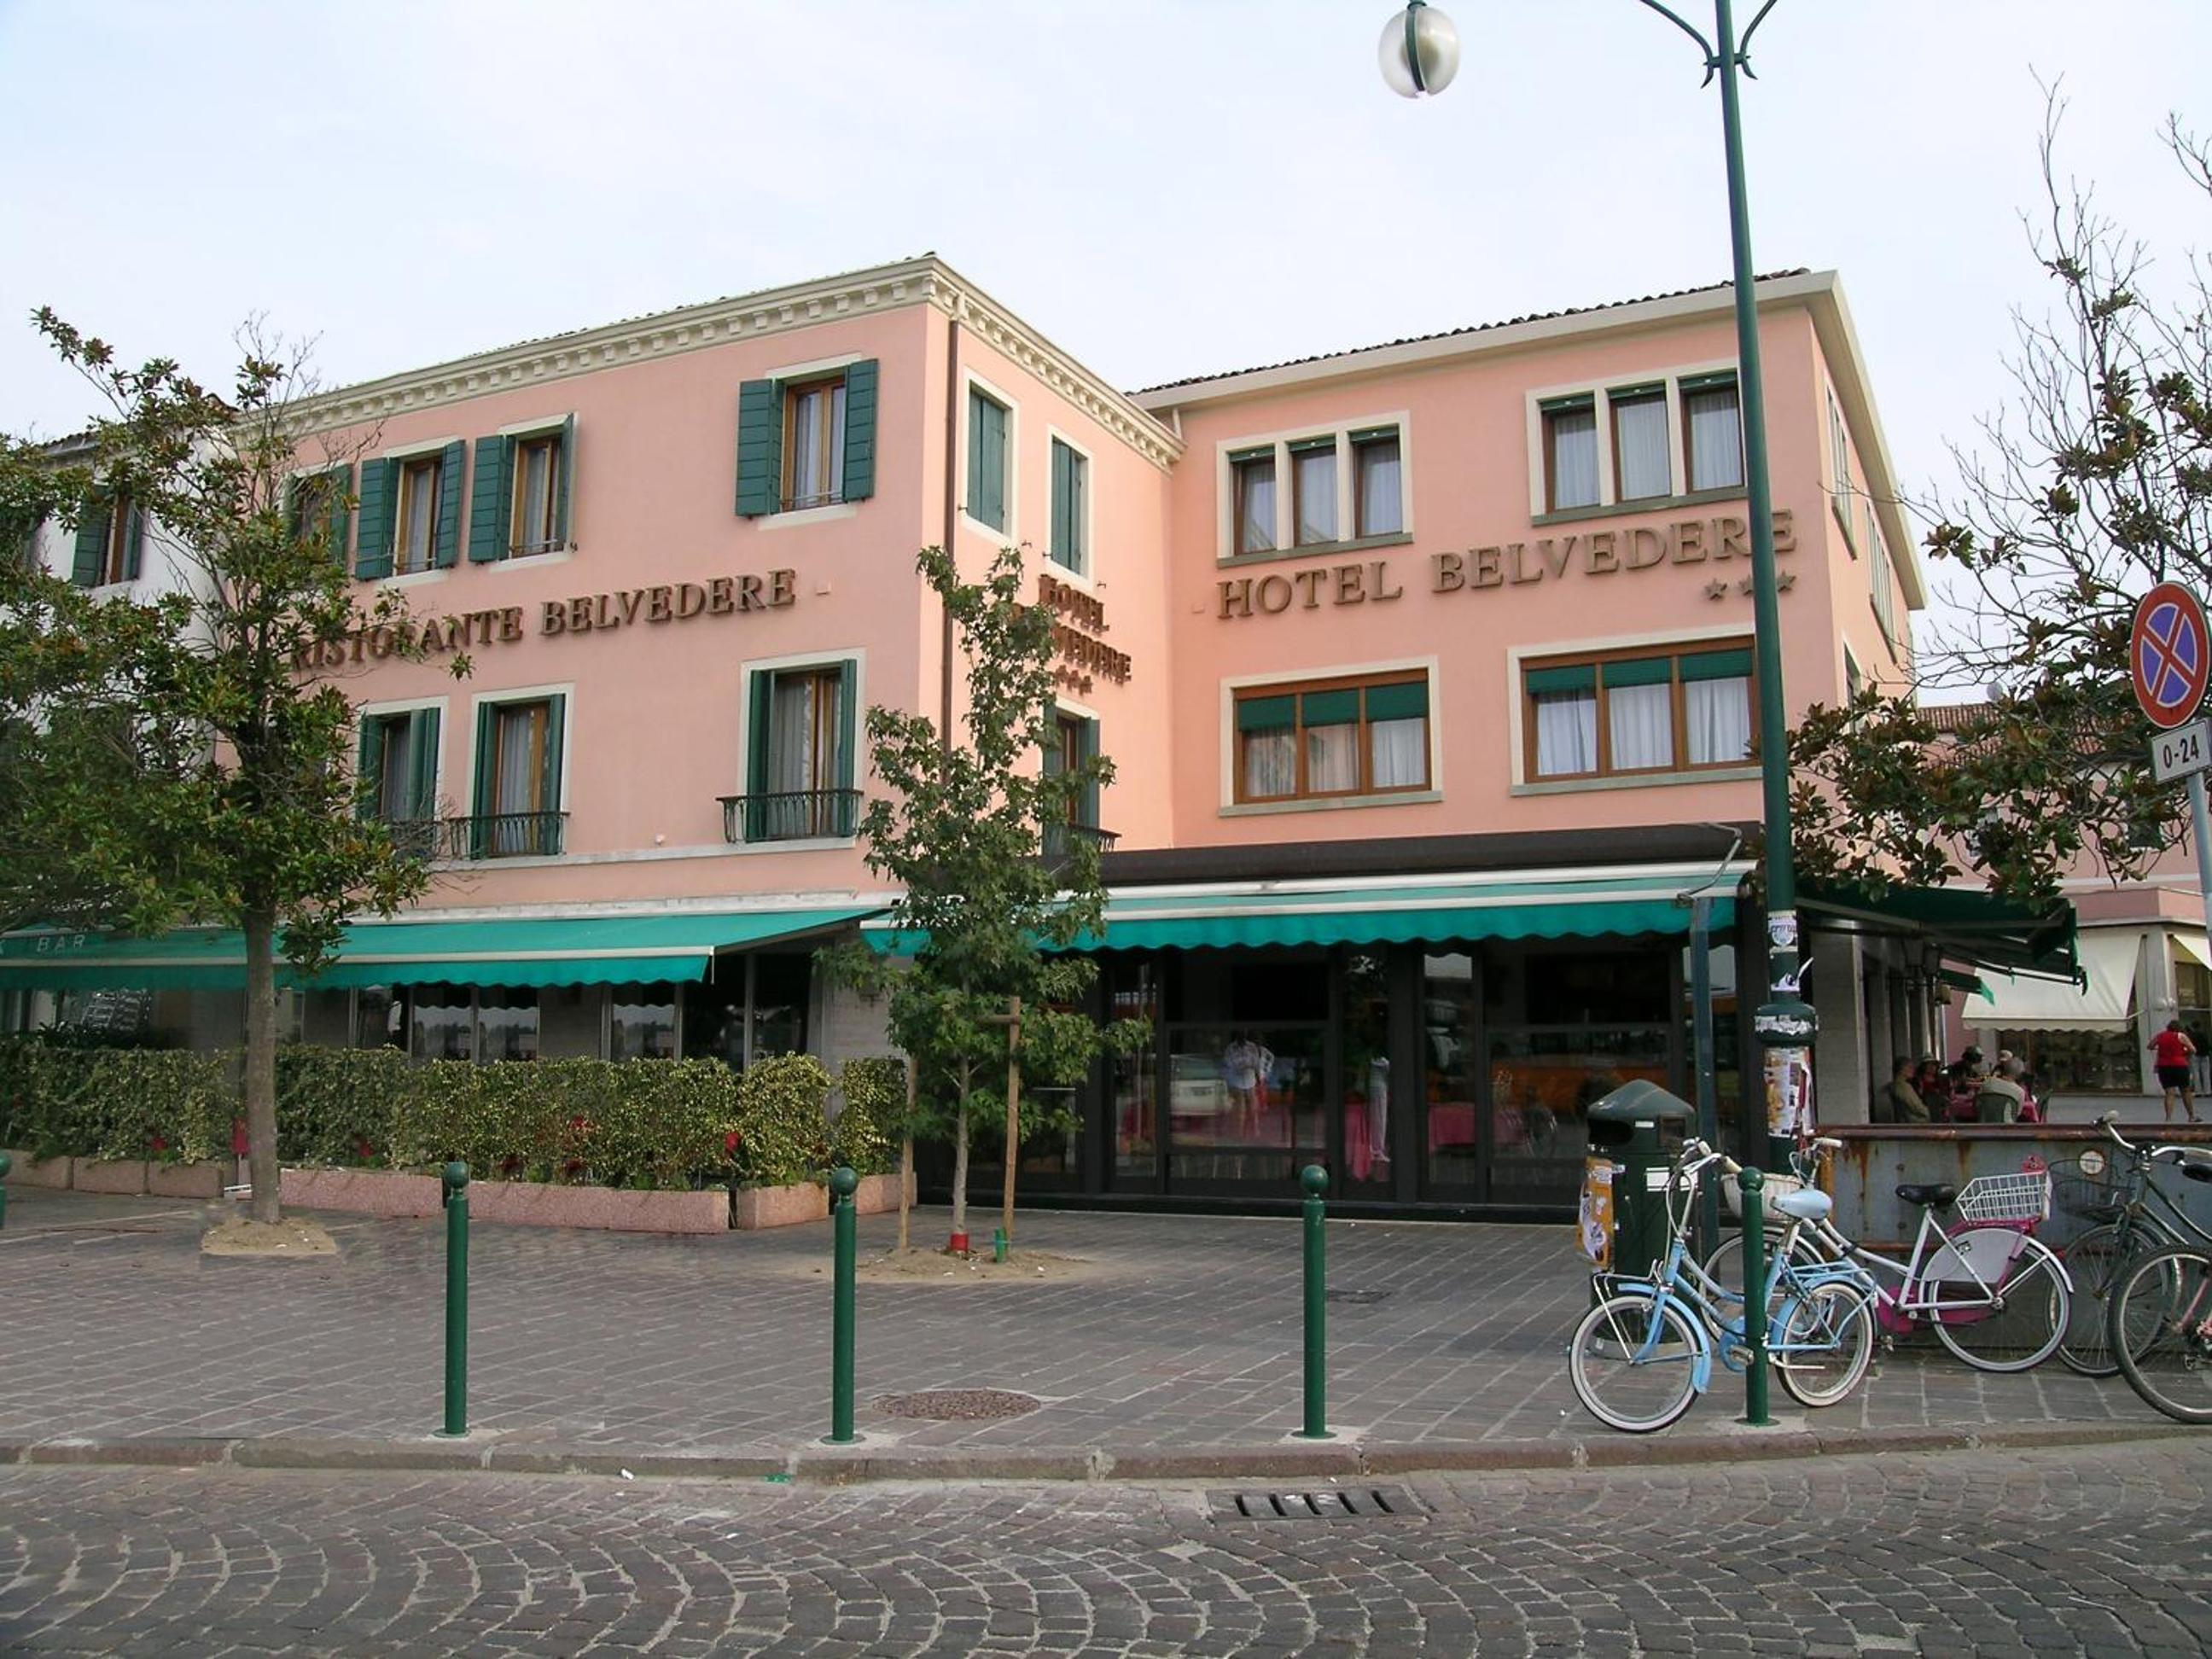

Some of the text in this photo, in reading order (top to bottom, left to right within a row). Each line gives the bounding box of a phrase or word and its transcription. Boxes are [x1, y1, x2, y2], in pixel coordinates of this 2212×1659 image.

[1216, 509, 1797, 620] HOTEL BELVEDERE
[539, 568, 796, 637] BELVEDERE
[2163, 734, 2199, 769] 0-24
